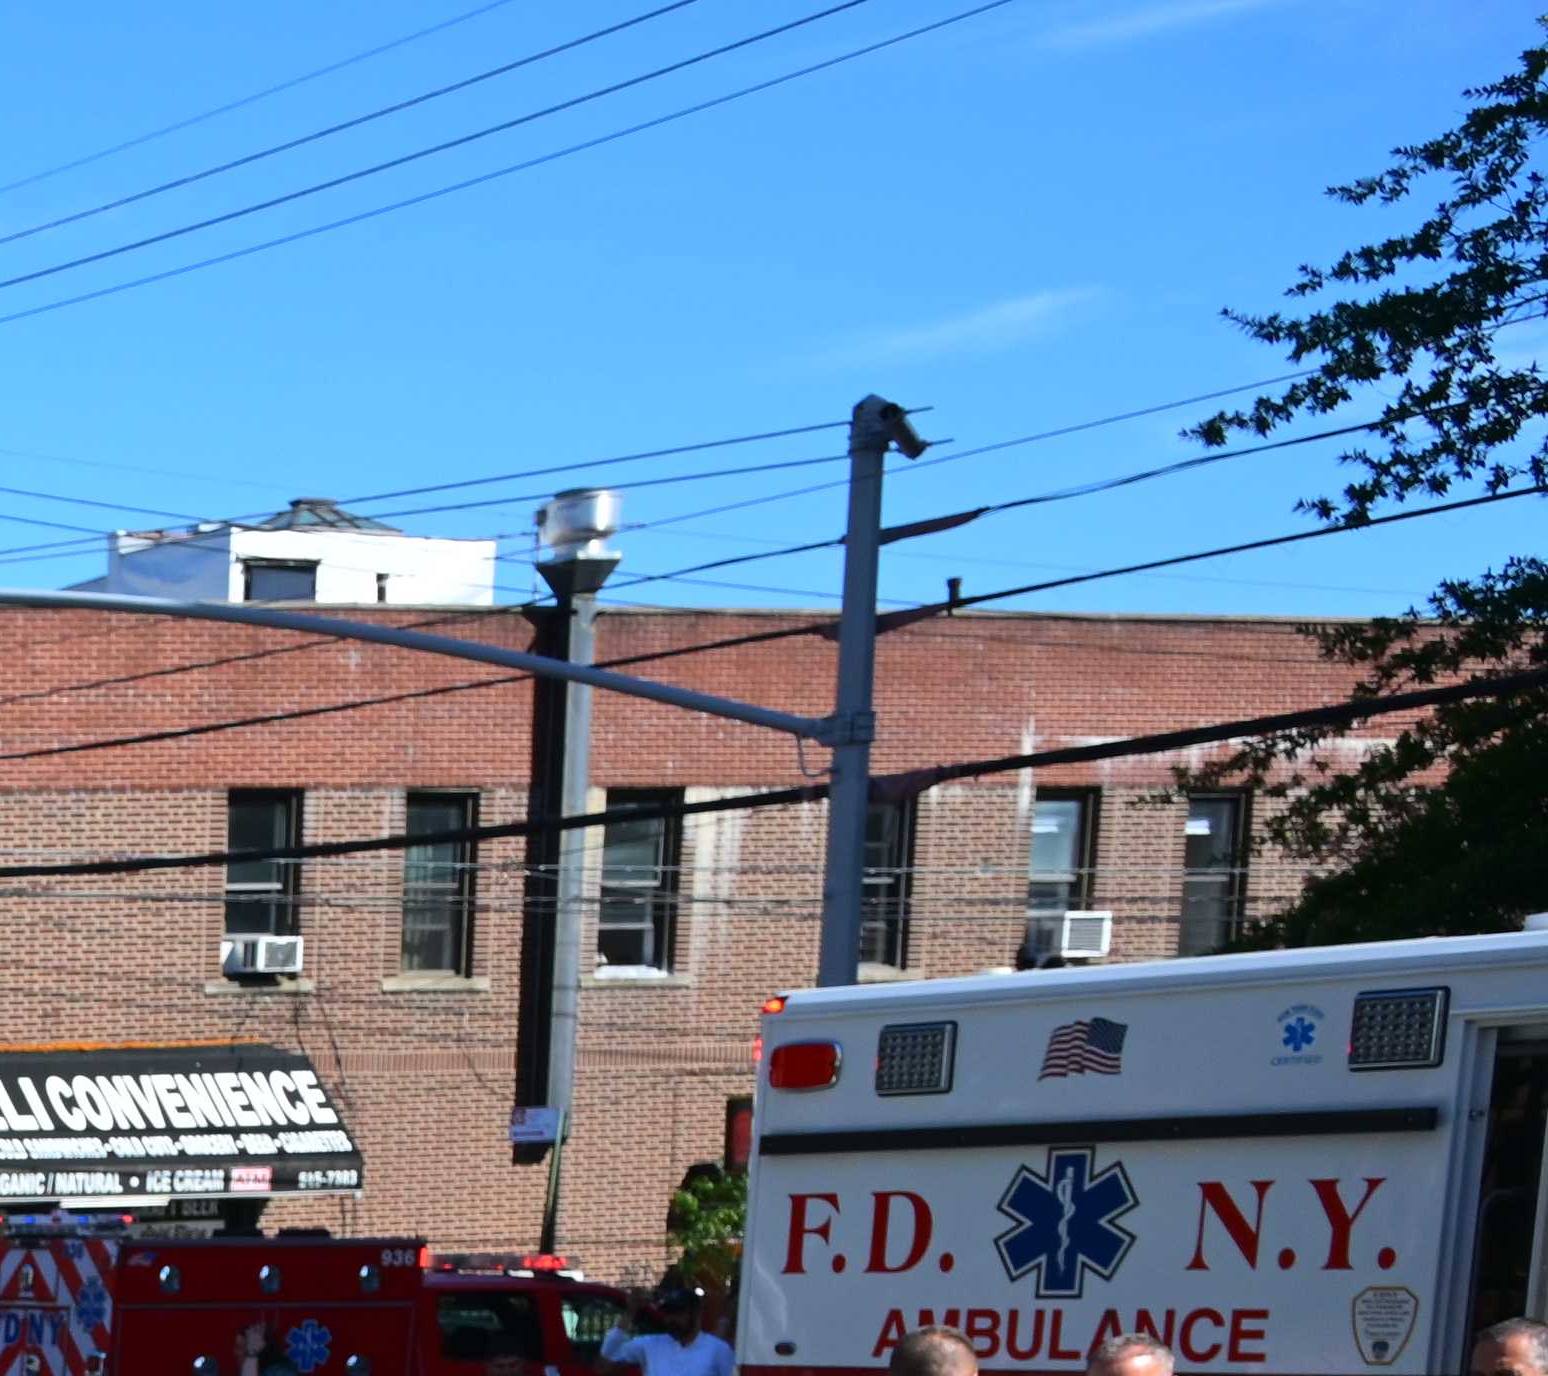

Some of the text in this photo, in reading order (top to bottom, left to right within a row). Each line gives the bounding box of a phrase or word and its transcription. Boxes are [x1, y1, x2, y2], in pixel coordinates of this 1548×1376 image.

[56, 1070, 339, 1132] CONVENIENCE
[55, 1172, 124, 1195] NATURAL
[146, 1171, 172, 1193] ICE
[172, 1169, 225, 1192] CREAM
[781, 1176, 1397, 1276] F.D. N.Y.
[381, 1249, 416, 1267] 936
